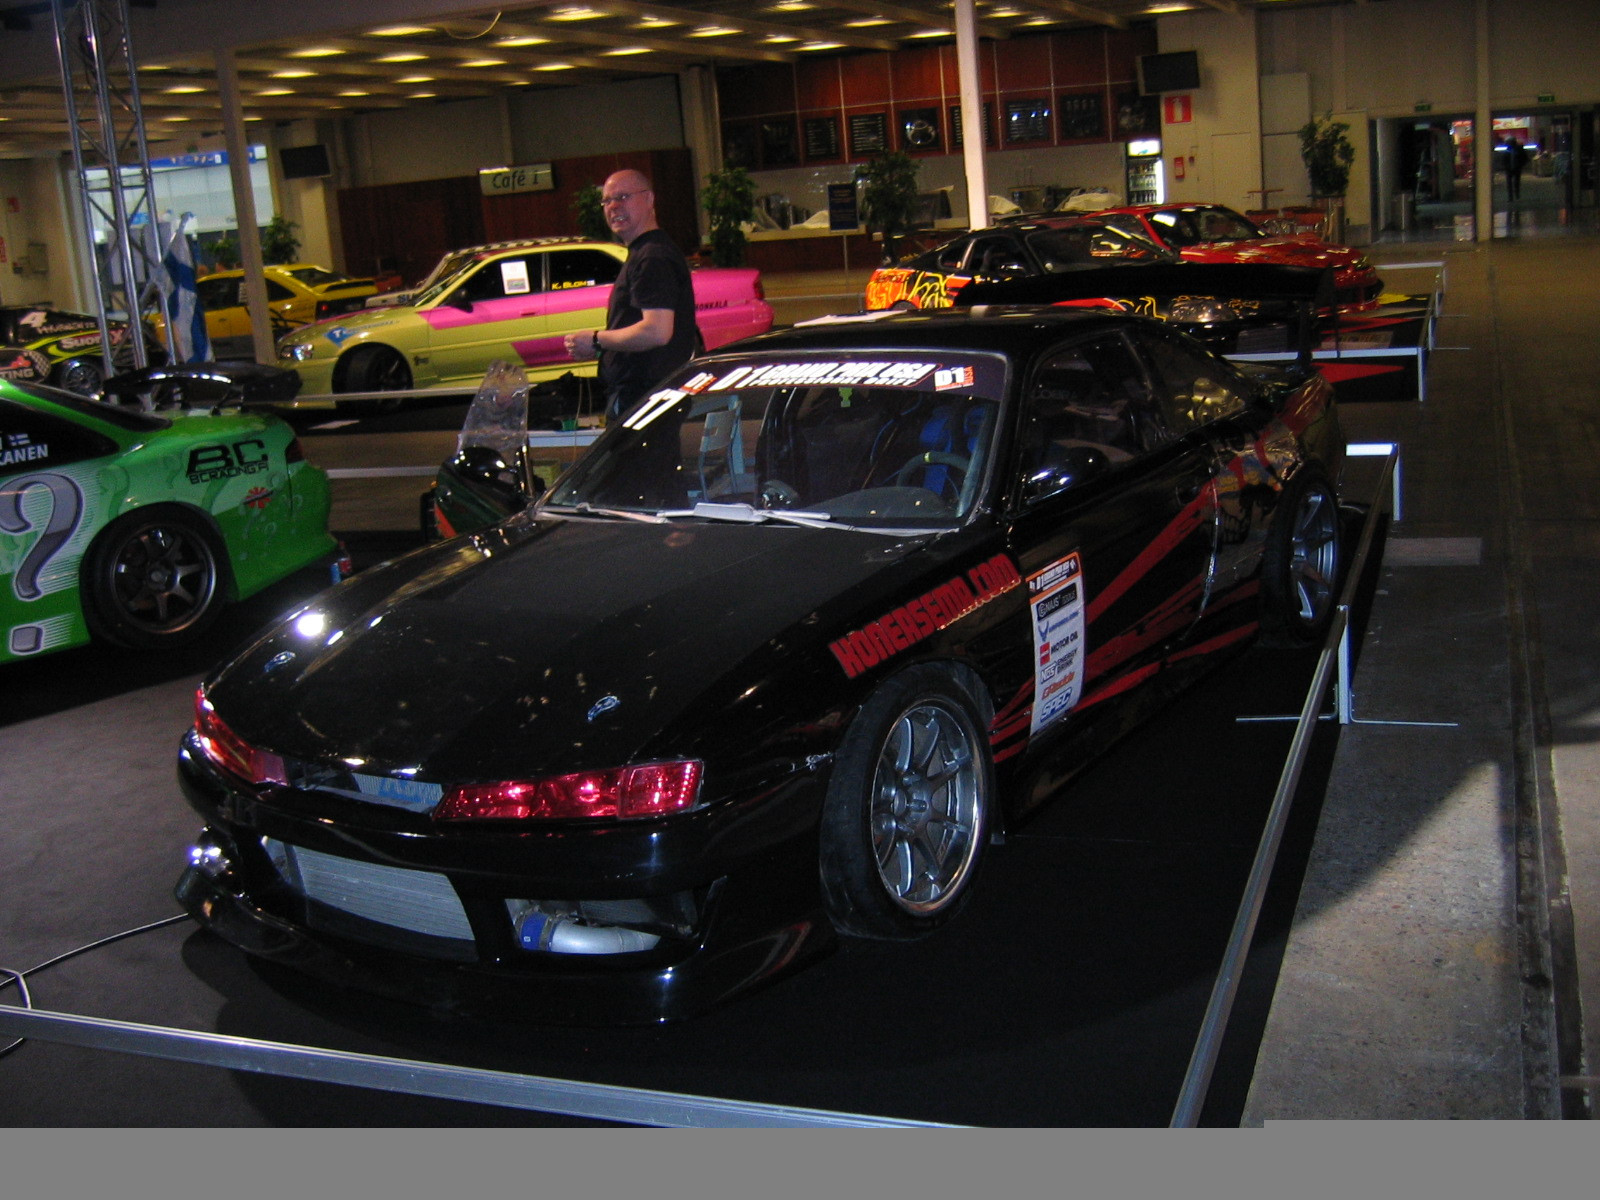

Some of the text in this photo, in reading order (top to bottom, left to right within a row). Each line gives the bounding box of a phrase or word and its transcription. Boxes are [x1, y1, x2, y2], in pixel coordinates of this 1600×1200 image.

[492, 170, 526, 190] Café
[186, 439, 269, 477] BC
[1050, 630, 1079, 655] MOTOR OIL
